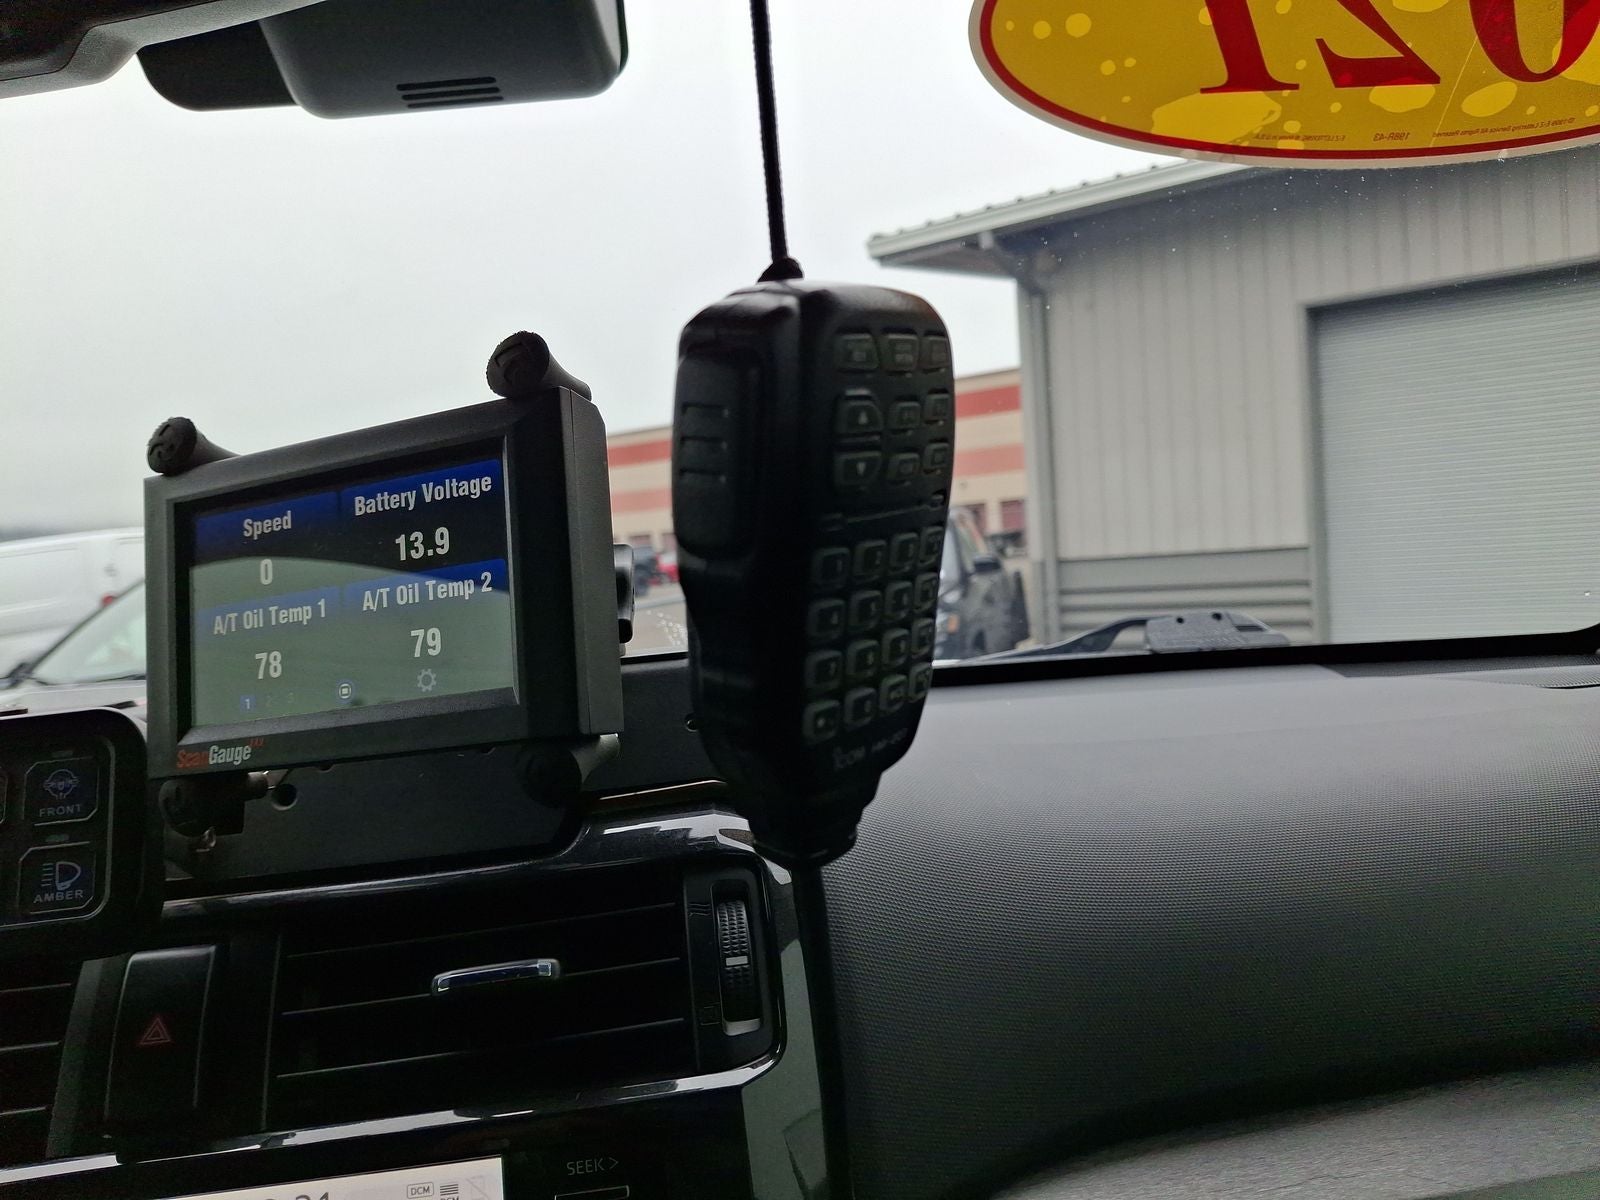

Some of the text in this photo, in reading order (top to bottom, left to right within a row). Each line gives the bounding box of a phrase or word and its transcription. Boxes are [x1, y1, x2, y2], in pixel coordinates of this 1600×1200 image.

[354, 476, 493, 516] Battery Voltage
[242, 510, 293, 541] Speed
[395, 526, 451, 562] 13.9
[259, 558, 274, 586] 0
[362, 571, 493, 613] A/T Oil Temp 2
[213, 598, 327, 636] A/T Oil Temp 1
[410, 627, 442, 658] 79
[255, 651, 283, 681] 78
[39, 803, 82, 818] FRONT
[33, 888, 84, 904] AMBER
[566, 1157, 605, 1176] SEEK
[410, 1186, 430, 1197] DCM
